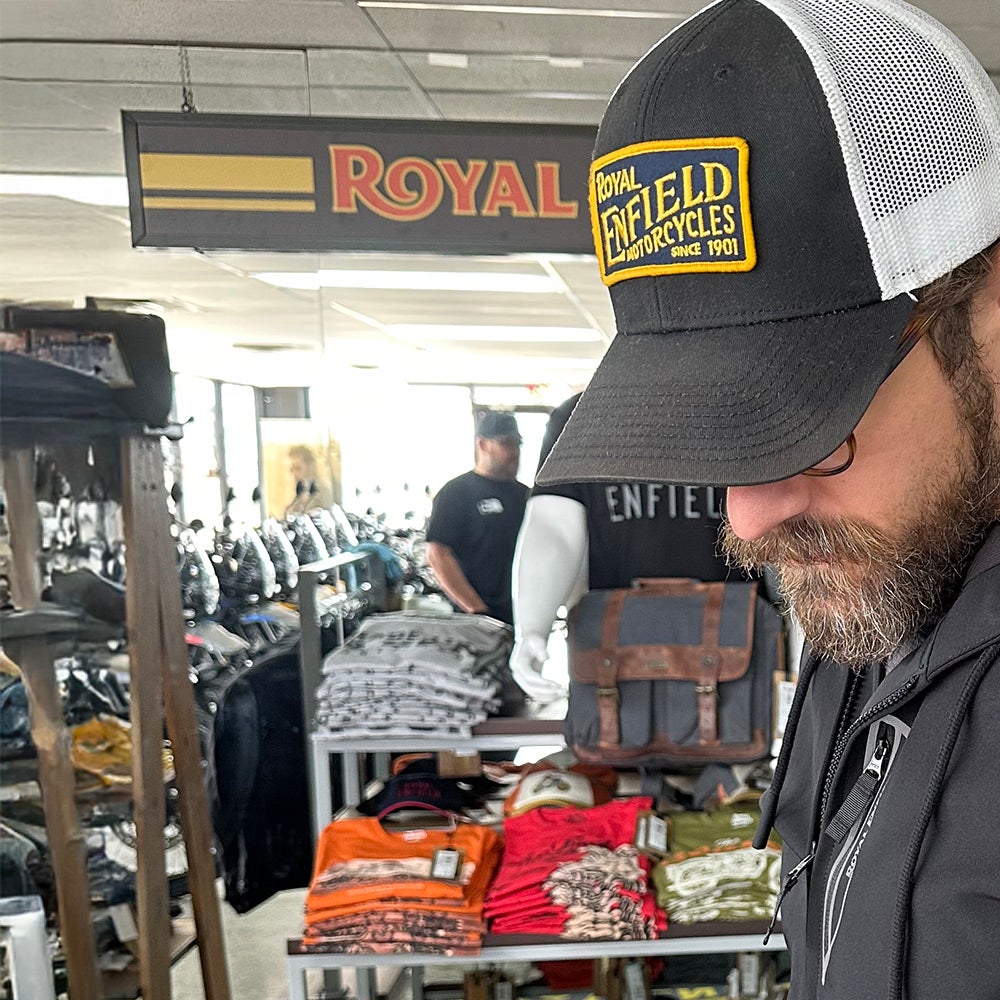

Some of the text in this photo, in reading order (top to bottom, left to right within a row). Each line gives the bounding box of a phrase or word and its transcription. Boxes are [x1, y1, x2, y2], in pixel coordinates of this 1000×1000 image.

[328, 144, 579, 222] ROYAL
[596, 167, 642, 204] ROYAL
[600, 162, 733, 268] ENFIELD
[626, 204, 736, 262] MOTORCYCLES
[671, 238, 739, 258] SINCE 1901
